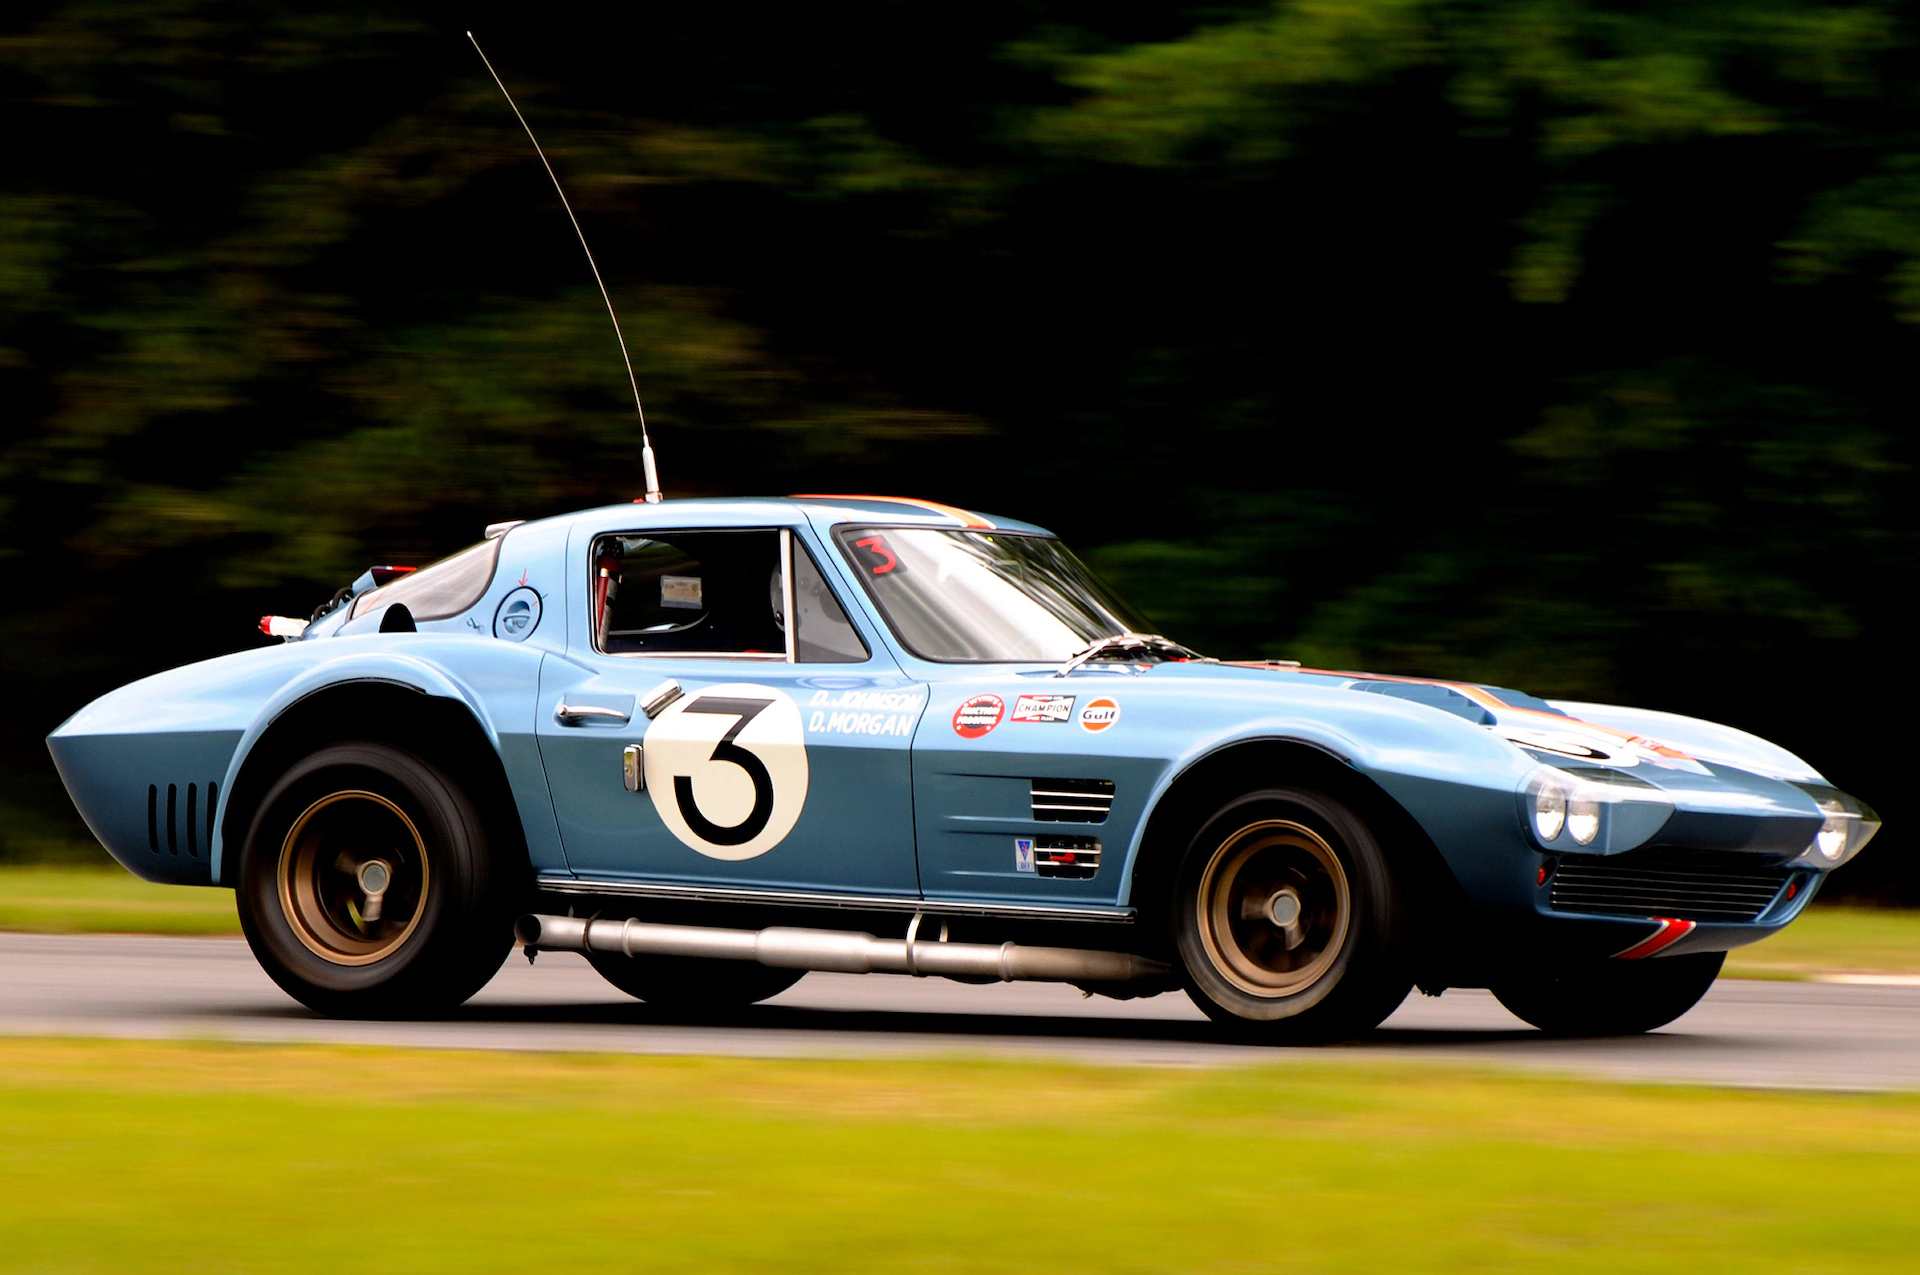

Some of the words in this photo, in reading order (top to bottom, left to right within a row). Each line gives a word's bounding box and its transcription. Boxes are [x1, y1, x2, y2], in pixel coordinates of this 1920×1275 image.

[856, 535, 897, 575] 3
[1018, 703, 1070, 713] CHAMPION
[1083, 709, 1116, 720] Gulf
[808, 710, 915, 737] D.MORGAN
[673, 696, 777, 846] 3
